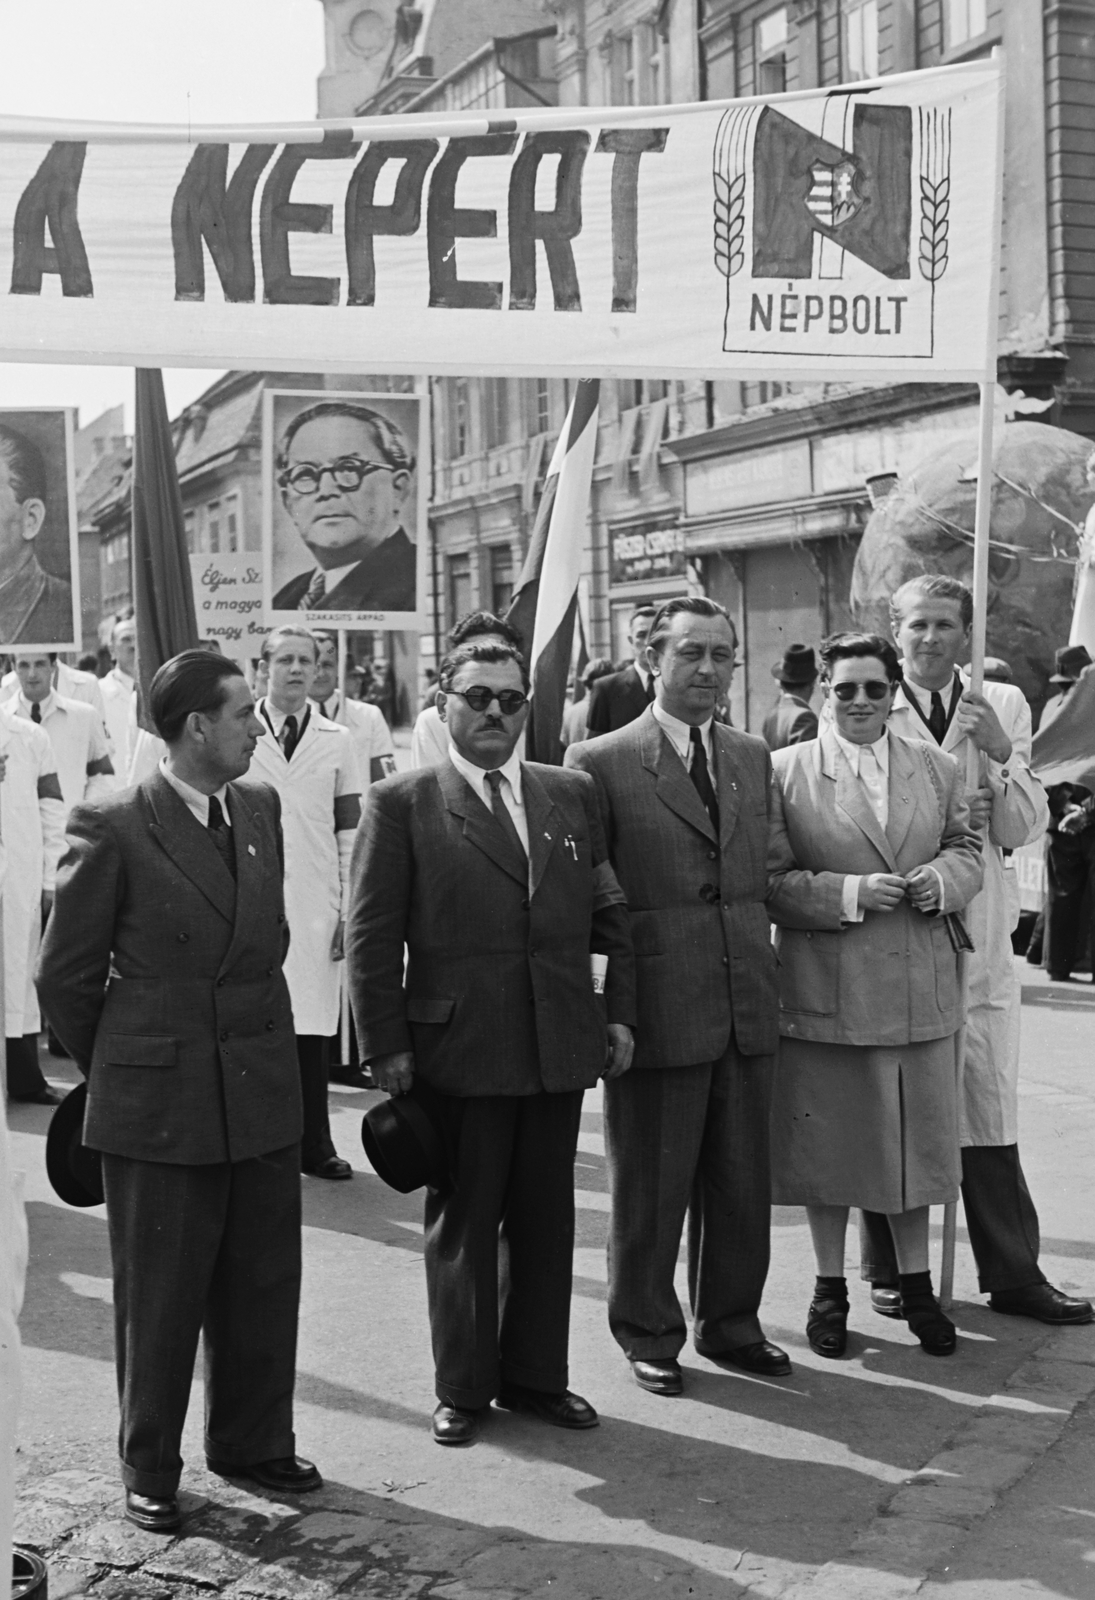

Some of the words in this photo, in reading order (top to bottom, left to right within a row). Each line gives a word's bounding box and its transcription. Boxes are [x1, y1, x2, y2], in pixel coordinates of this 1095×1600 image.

[10, 140, 95, 298] A
[748, 282, 909, 335] NÉPBOLT
[201, 563, 237, 592] Éljen
[202, 602, 210, 610] a
[206, 626, 242, 640] nagy
